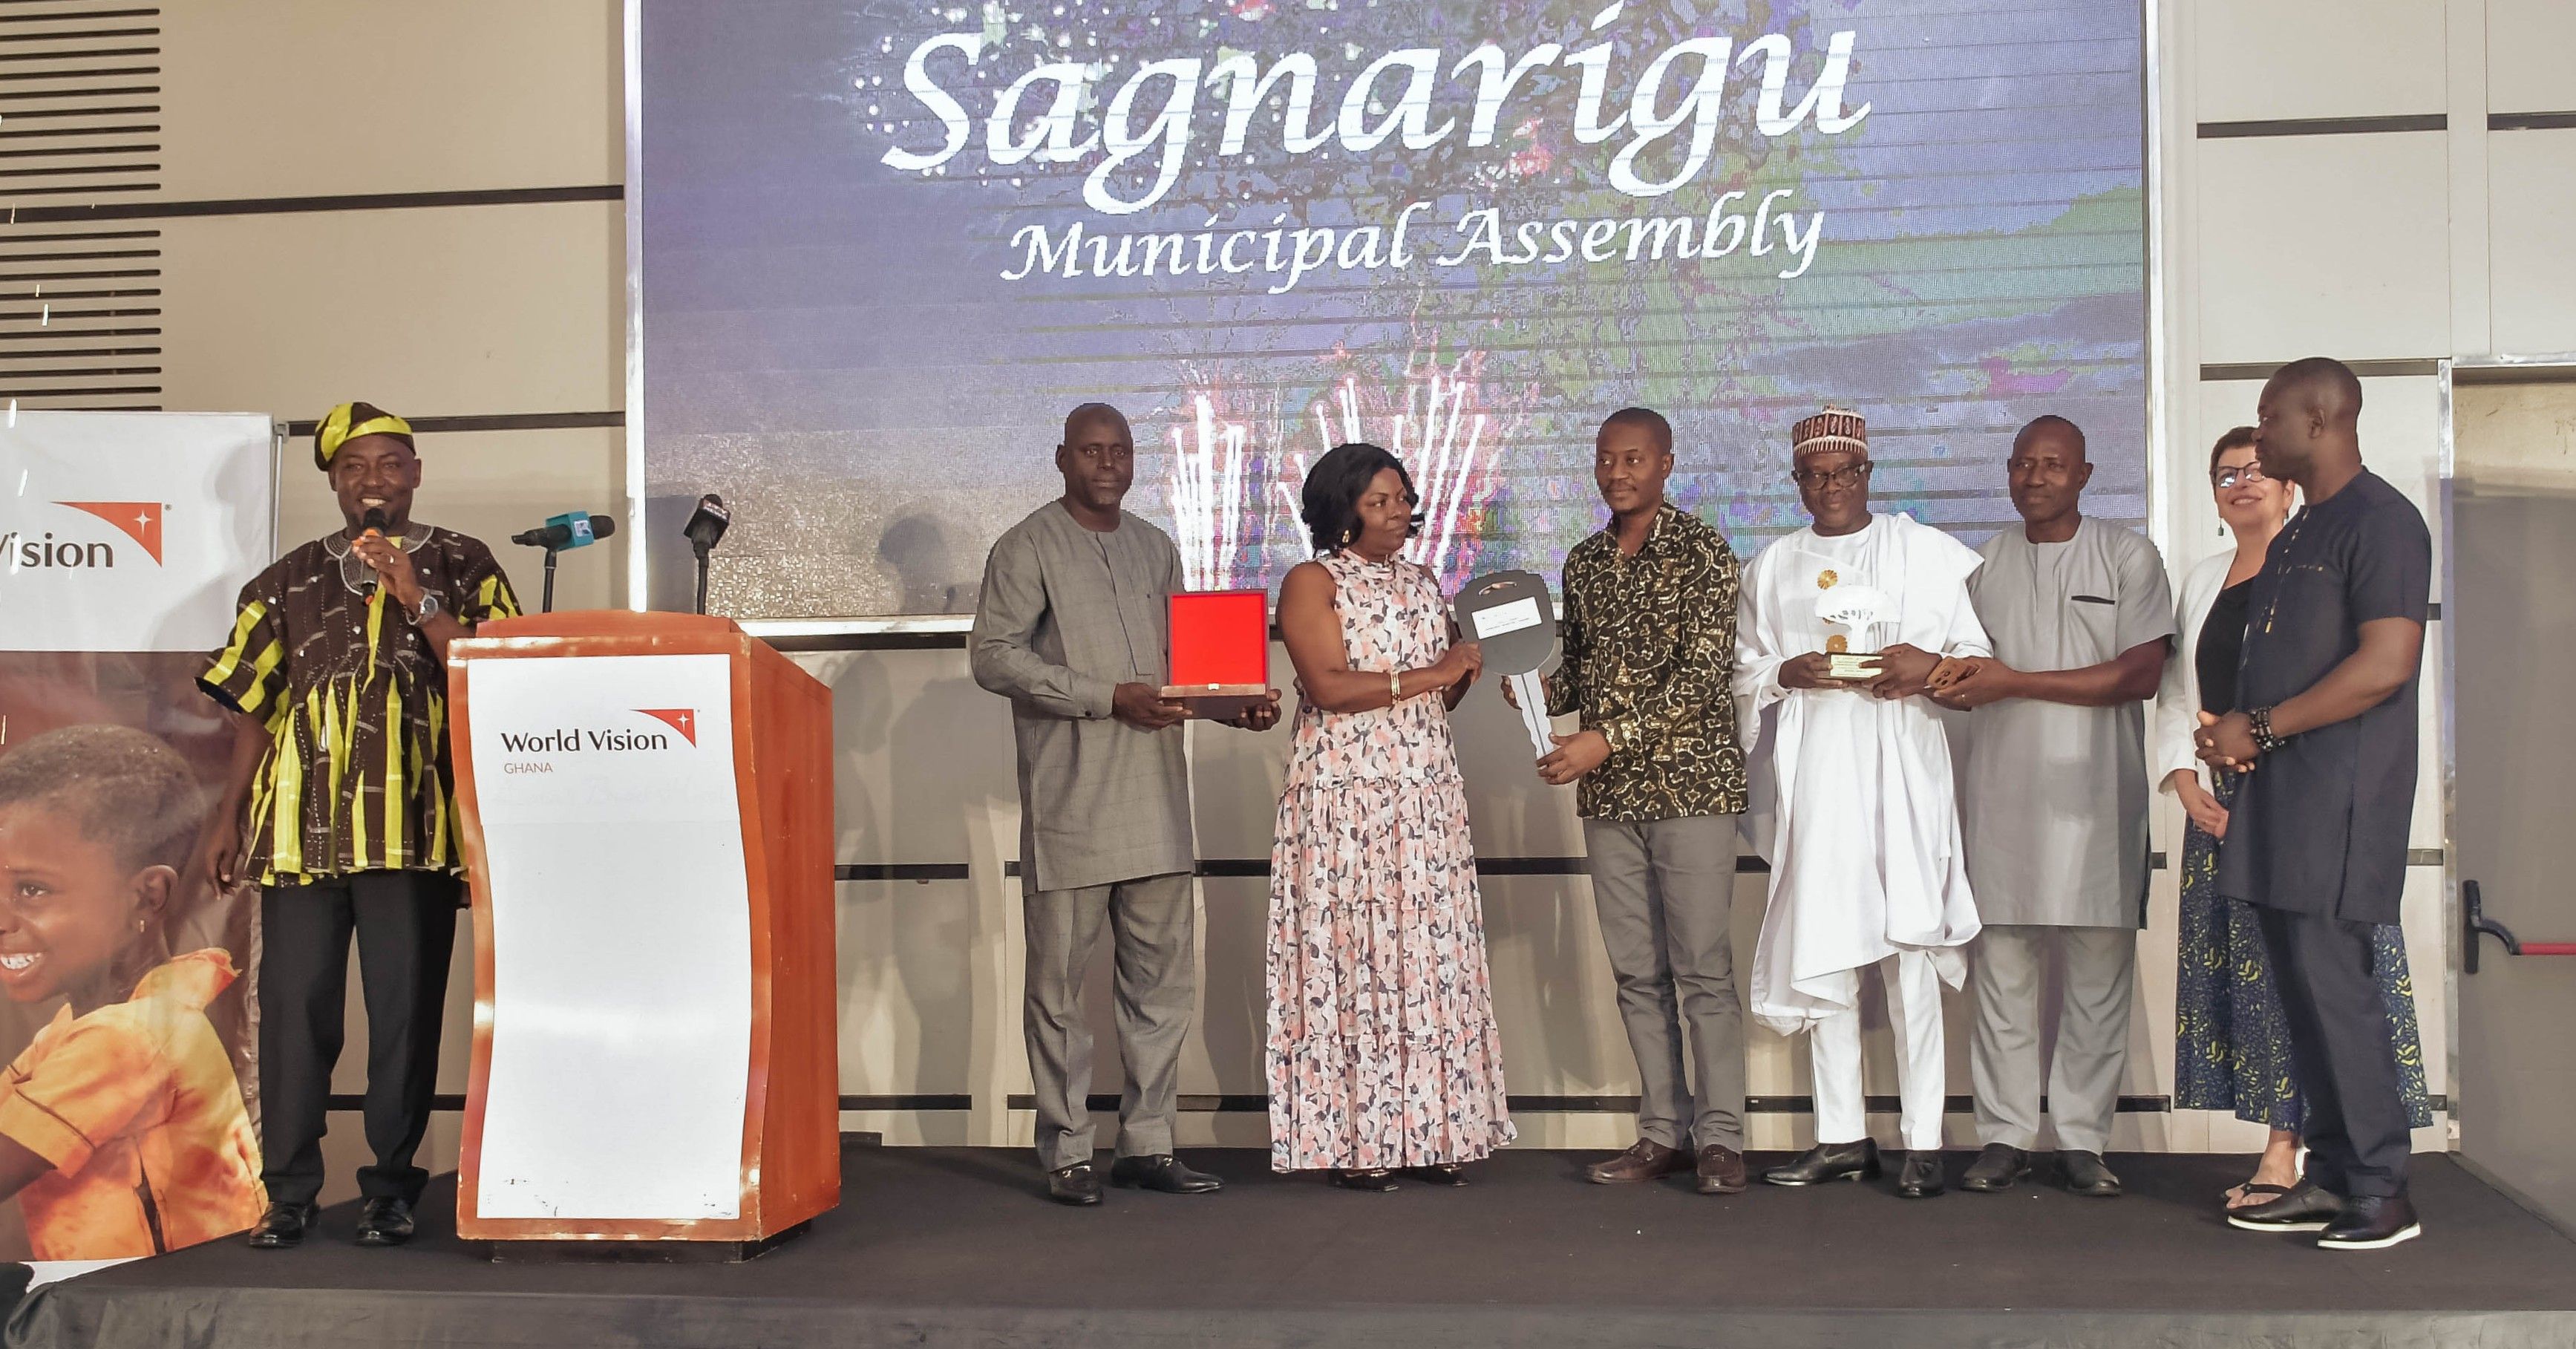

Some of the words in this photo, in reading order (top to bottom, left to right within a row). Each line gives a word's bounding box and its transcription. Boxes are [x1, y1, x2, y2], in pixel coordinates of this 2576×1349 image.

[880, 0, 1871, 215] Sagnarigu
[1000, 201, 1434, 294] Municipal
[1436, 189, 1825, 279] Assembly
[500, 728, 581, 752] World
[587, 728, 668, 751] Vision
[503, 762, 554, 774] GHANA
